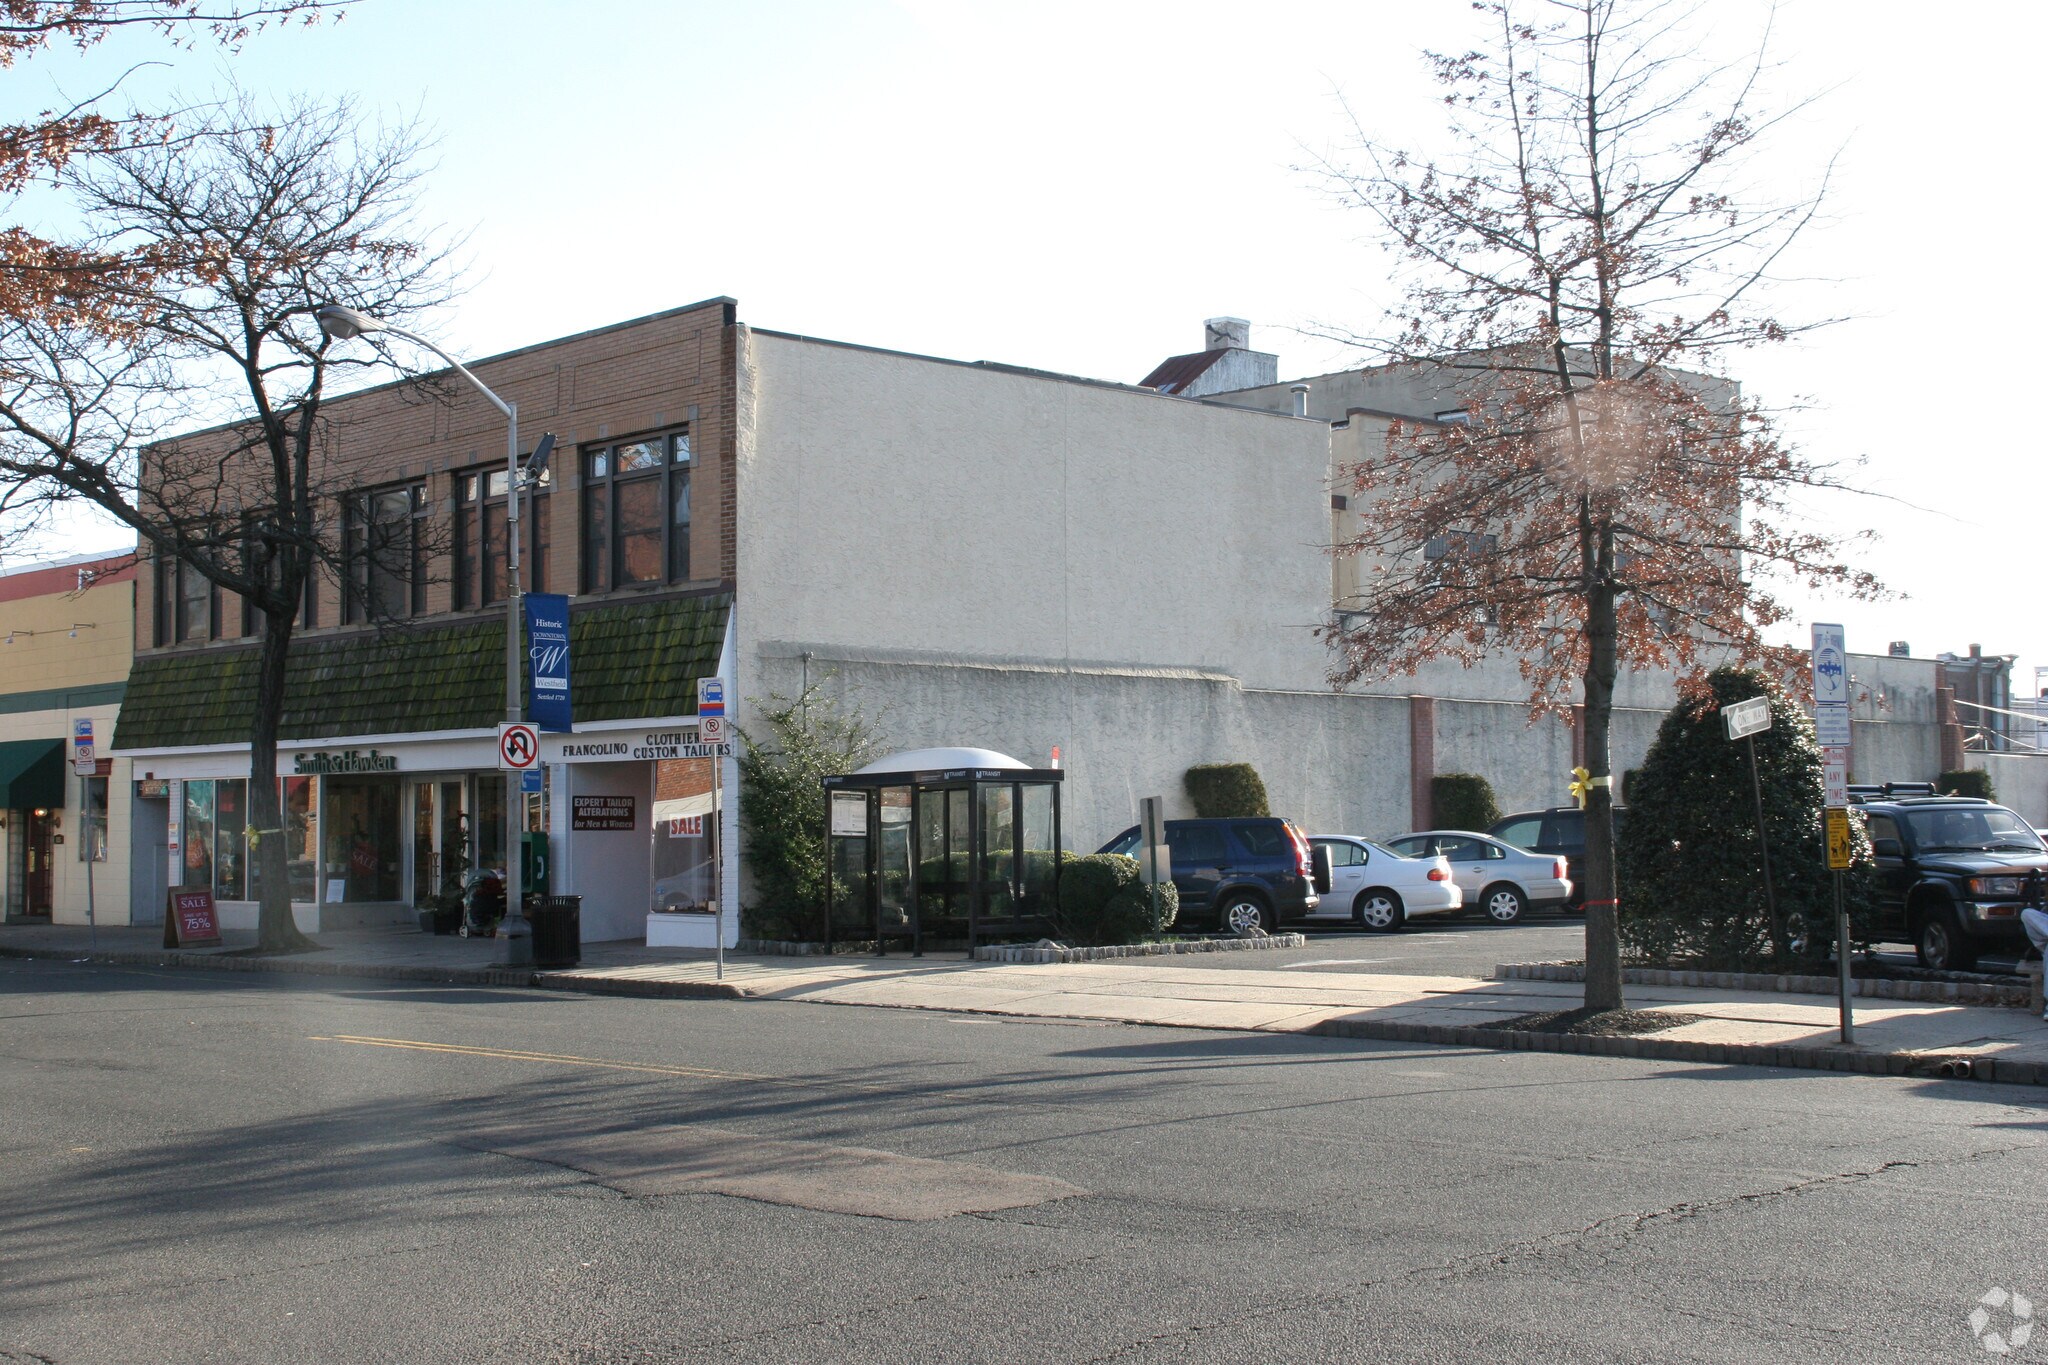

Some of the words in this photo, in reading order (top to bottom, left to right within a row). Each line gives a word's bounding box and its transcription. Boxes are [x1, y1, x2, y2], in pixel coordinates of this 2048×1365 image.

[536, 618, 562, 628] Historic
[530, 646, 568, 673] W
[537, 678, 566, 688] Westfield
[1737, 711, 1750, 727] ONE
[1752, 705, 1767, 721] WAY
[646, 732, 699, 746] CLOTHIER
[562, 743, 628, 757] FRANCOLINO
[633, 746, 679, 759] CUSTOM
[294, 752, 328, 775] Smith
[342, 749, 397, 772] Hawken
[1829, 771, 1840, 782] ANY
[1828, 788, 1843, 800] TIME
[574, 798, 604, 807] EXPERT
[606, 798, 633, 807] TAILOR
[578, 807, 629, 817] ALTERATIONS
[574, 819, 585, 828] for
[585, 820, 600, 828] Men
[609, 820, 633, 828] Women
[671, 816, 702, 835] SALE
[352, 851, 376, 870] SALE
[181, 899, 207, 909] SALE
[185, 918, 211, 929] 75%
